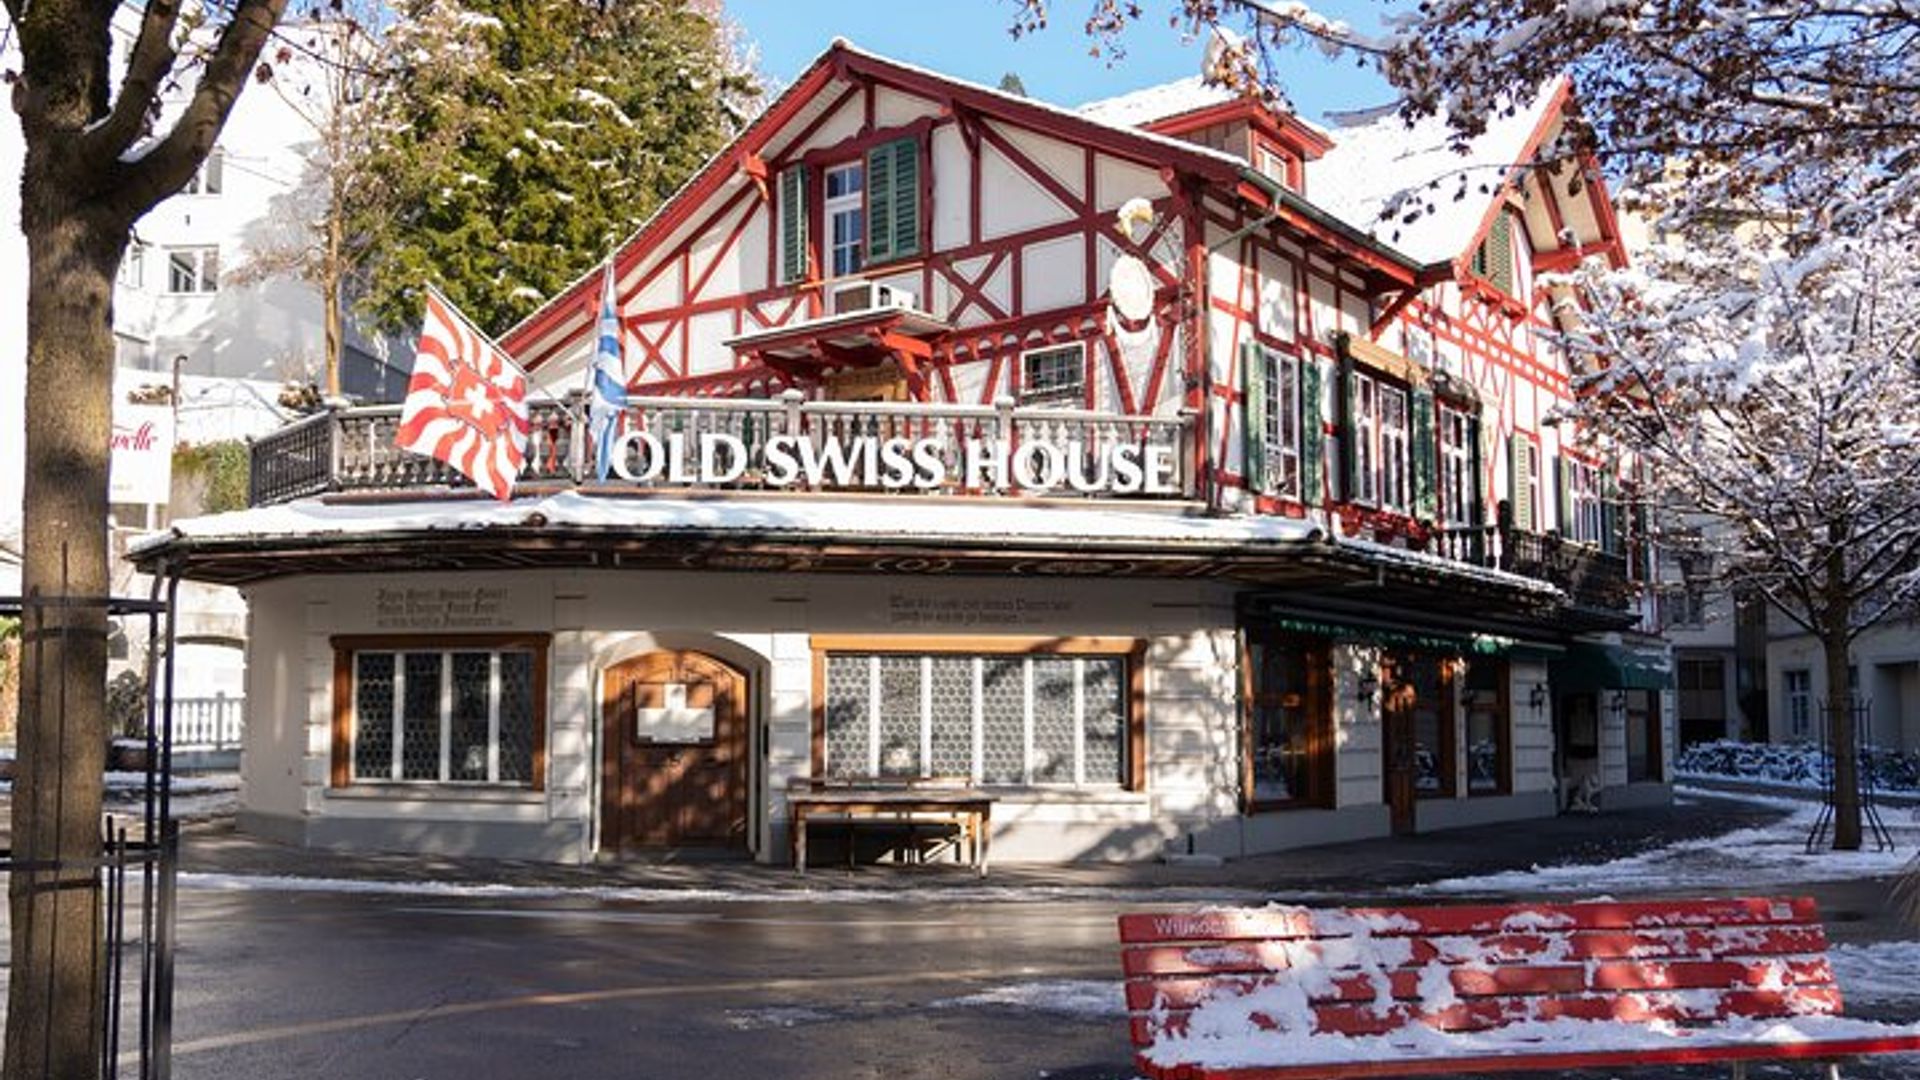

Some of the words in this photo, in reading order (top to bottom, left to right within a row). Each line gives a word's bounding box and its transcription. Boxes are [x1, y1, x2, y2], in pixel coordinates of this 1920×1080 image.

[612, 431, 748, 483] OLD
[764, 436, 945, 489] SWISS
[966, 440, 1175, 494] HOUSE
